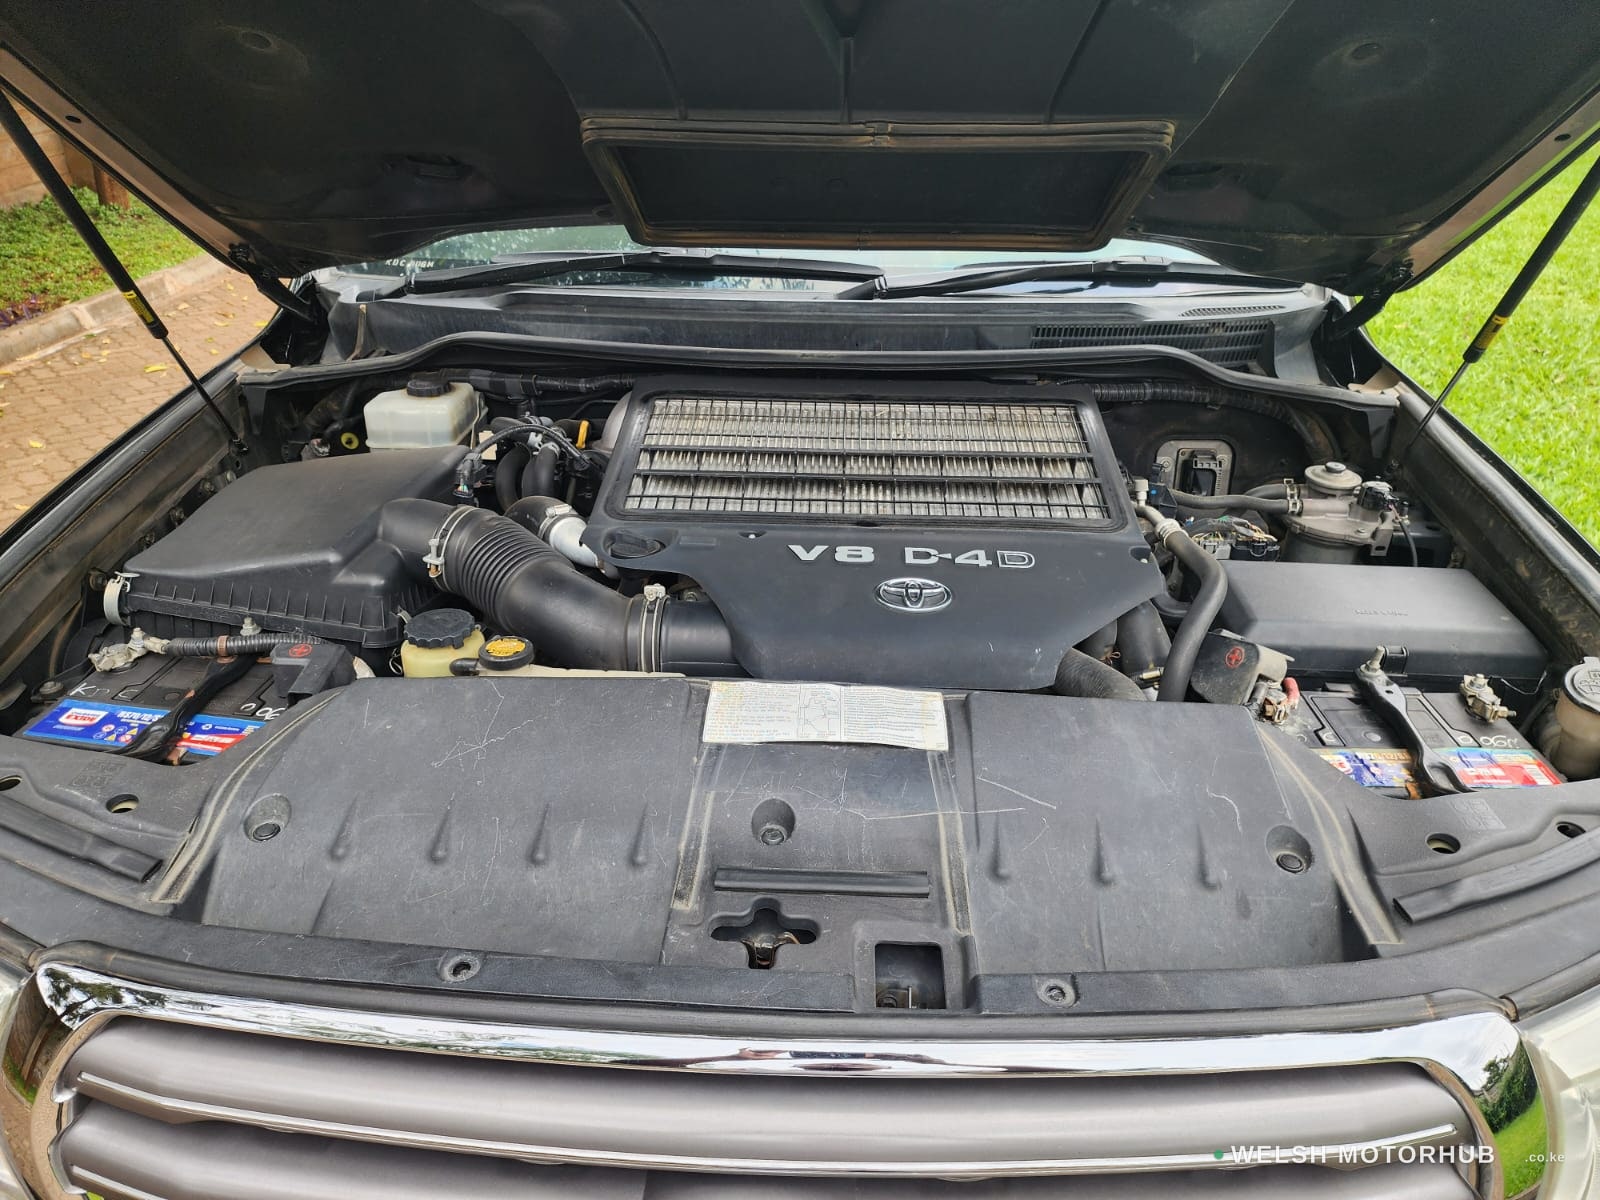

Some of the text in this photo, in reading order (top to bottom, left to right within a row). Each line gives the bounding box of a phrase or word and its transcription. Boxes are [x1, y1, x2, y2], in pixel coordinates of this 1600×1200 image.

[385, 258, 406, 267] KDC
[787, 544, 1036, 569] V8 D-4D
